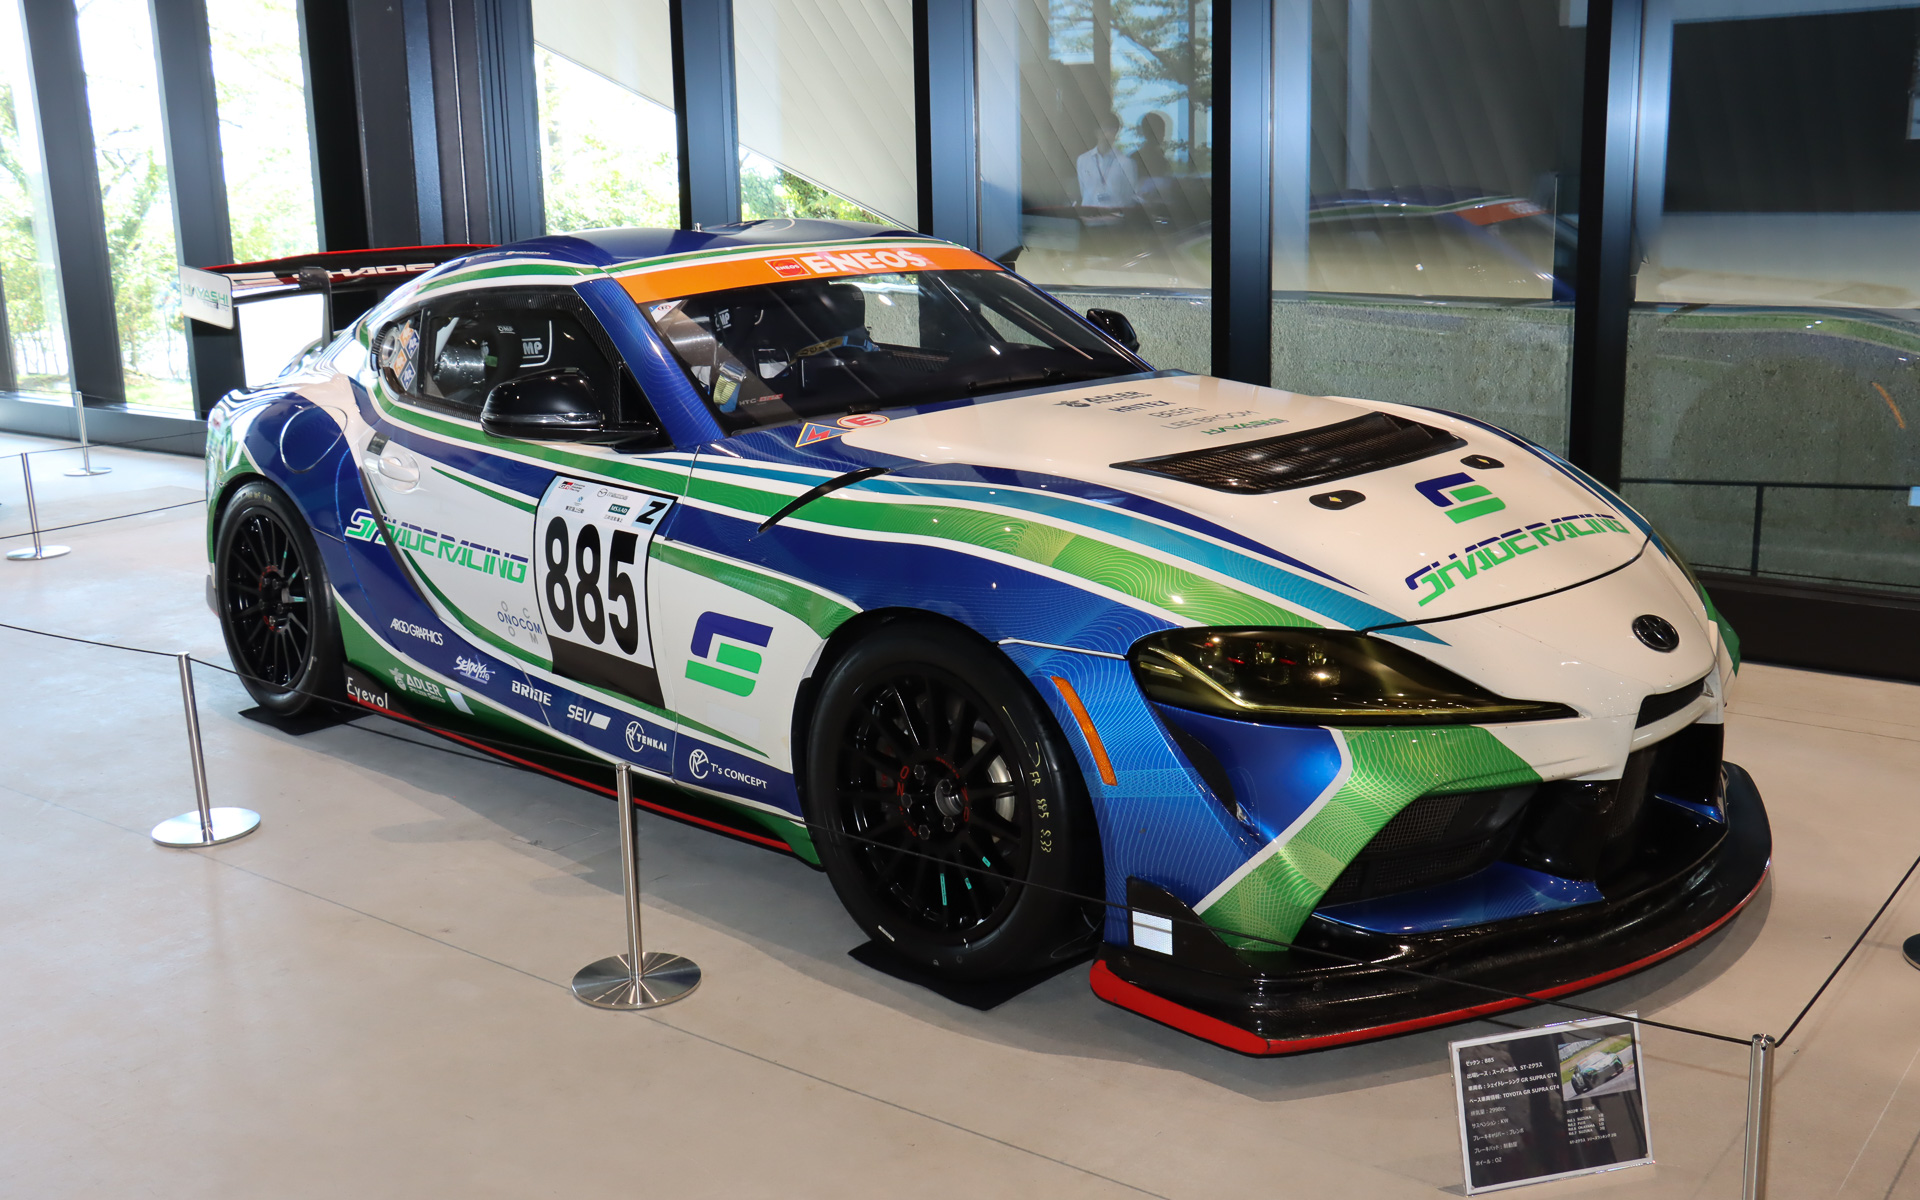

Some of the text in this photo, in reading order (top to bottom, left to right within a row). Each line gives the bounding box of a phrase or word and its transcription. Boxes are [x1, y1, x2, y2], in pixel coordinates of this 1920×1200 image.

[774, 250, 927, 274] ENEOS ENEOS
[183, 282, 230, 307] HAYASHI
[636, 501, 668, 525] Z
[1525, 513, 1630, 547] RACING
[437, 533, 529, 584] RACING
[545, 516, 639, 655] 885
[497, 610, 542, 635] ONOCOM
[346, 676, 389, 710] Eyevol
[406, 673, 443, 697] ADLER
[511, 680, 552, 707] BRIDE
[567, 704, 593, 724] SEV
[636, 732, 667, 752] TENKAI
[711, 763, 768, 790] T's CONCEPT
[1529, 1073, 1547, 1081] SUPRA
[1531, 1086, 1549, 1094] SUPRA
